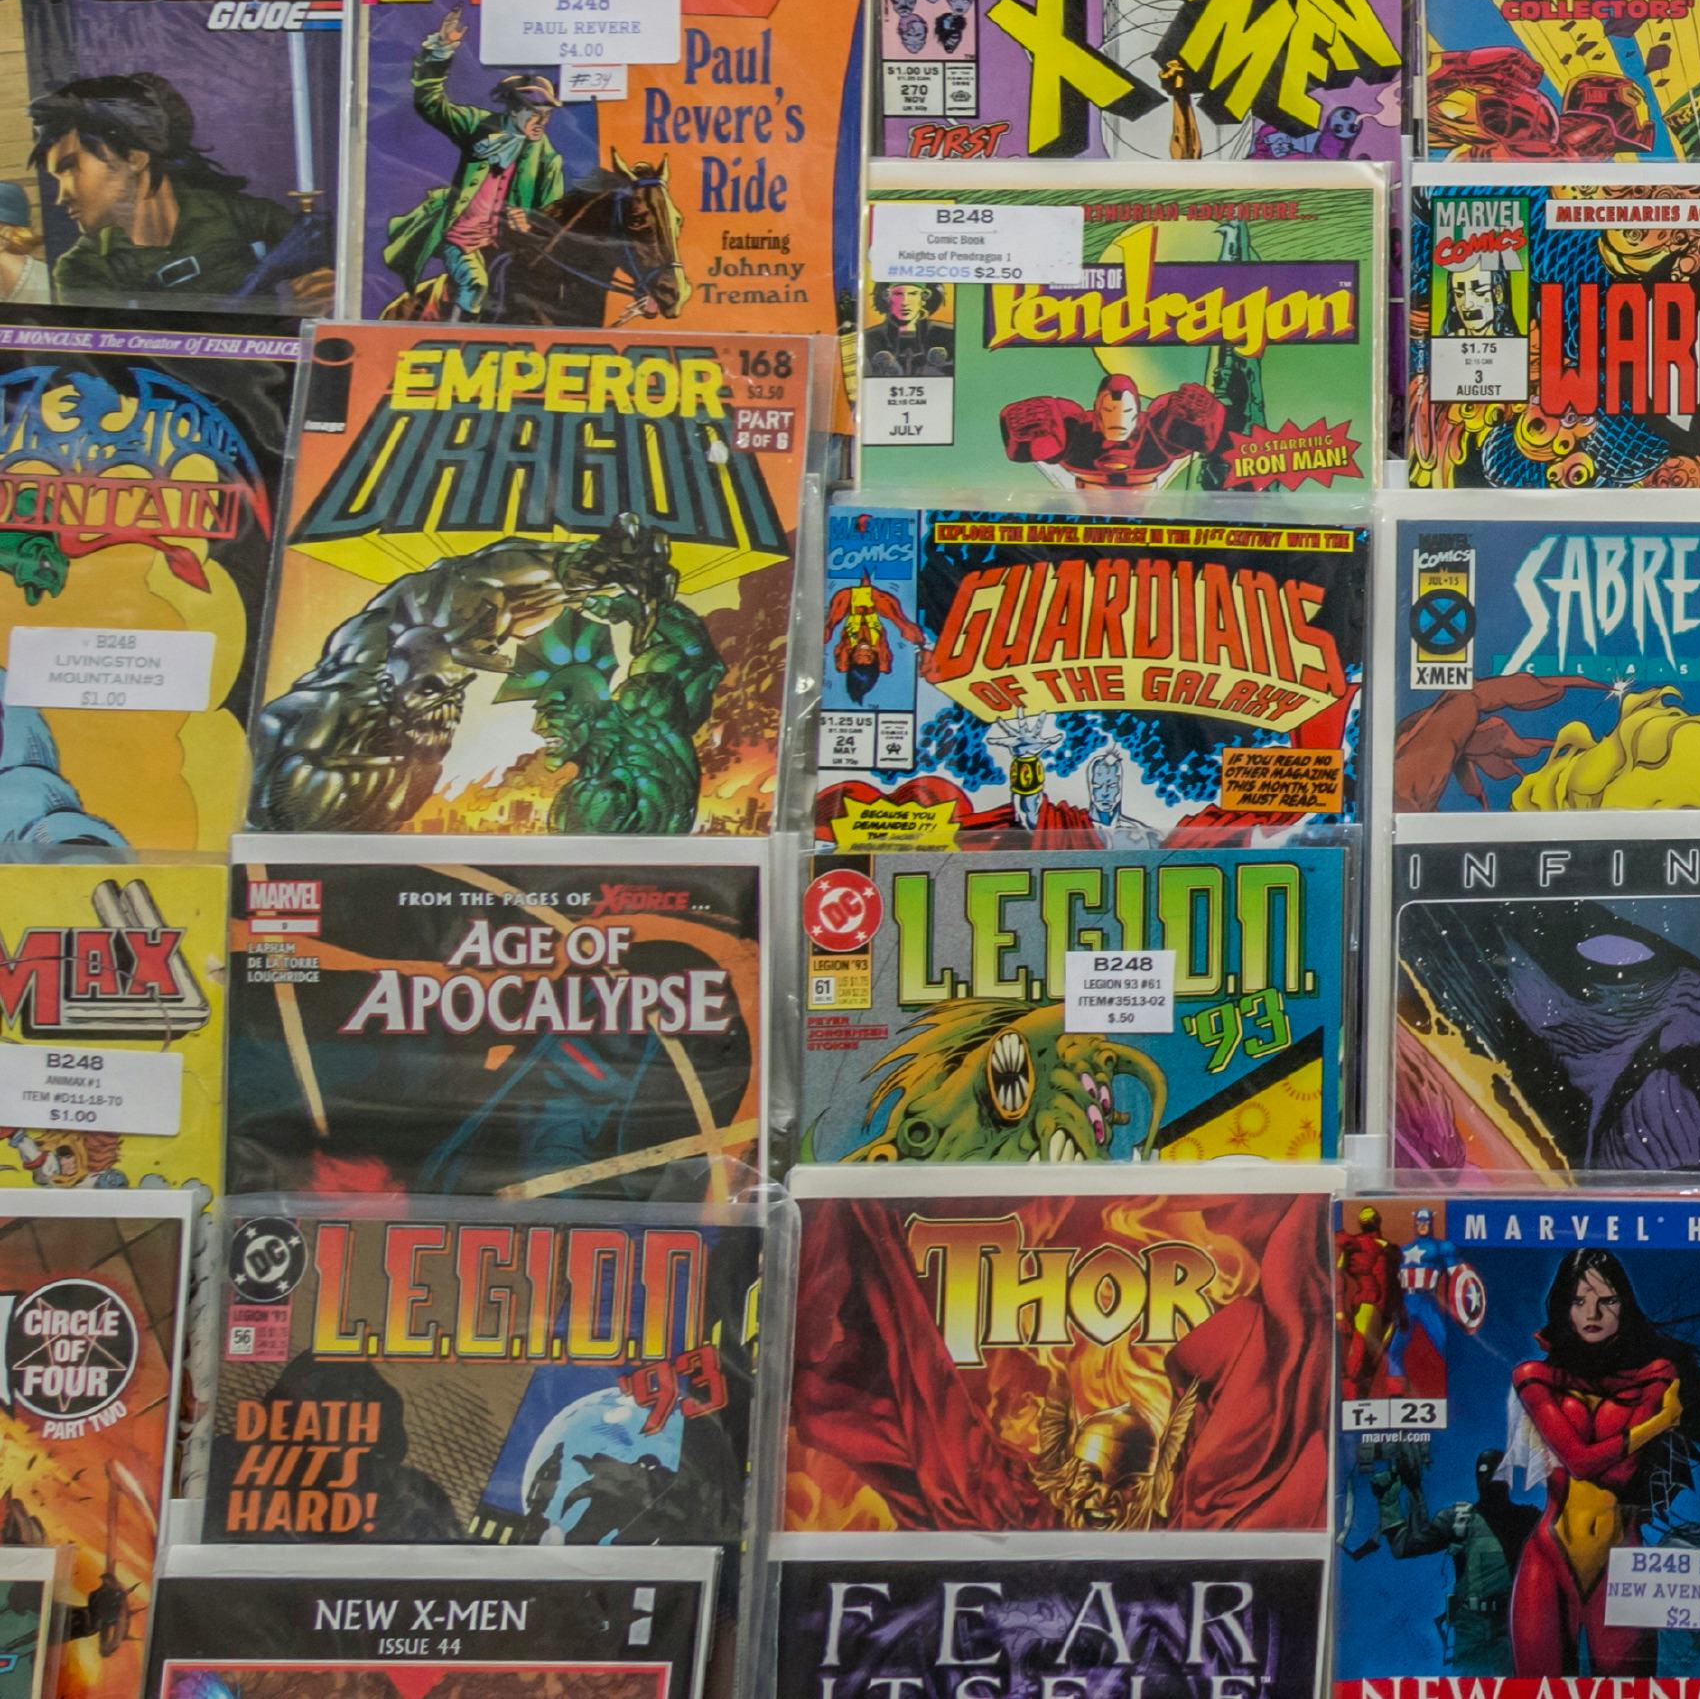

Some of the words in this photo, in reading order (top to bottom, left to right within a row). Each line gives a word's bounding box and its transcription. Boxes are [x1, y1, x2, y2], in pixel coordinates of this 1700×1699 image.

[685, 29, 771, 86] Paul
[644, 95, 804, 143] Revere's
[701, 154, 787, 214] Ride
[936, 209, 994, 225] B248
[1555, 206, 1679, 224] MERCENARIES
[708, 258, 804, 281] Johnny
[698, 282, 808, 304] Tremain
[399, 350, 723, 418] EMPEROR
[738, 350, 792, 378] 168
[941, 559, 1340, 681] GUARDIANS
[452, 922, 566, 965] AGE
[581, 921, 631, 962] OF
[1093, 957, 1153, 973] B248
[340, 972, 730, 1033] APOCALYPSE
[1465, 1216, 1649, 1239] MARVEL
[906, 1214, 1215, 1369] THOR
[236, 1400, 379, 1442] DEATH
[236, 1446, 369, 1486] HITS
[227, 1493, 376, 1531] HARD!
[1632, 1553, 1690, 1575] B248
[314, 1600, 399, 1630] NEW
[411, 1600, 527, 1630] X-MEN
[378, 1639, 428, 1655] ISSUE
[438, 1639, 461, 1655] 44
